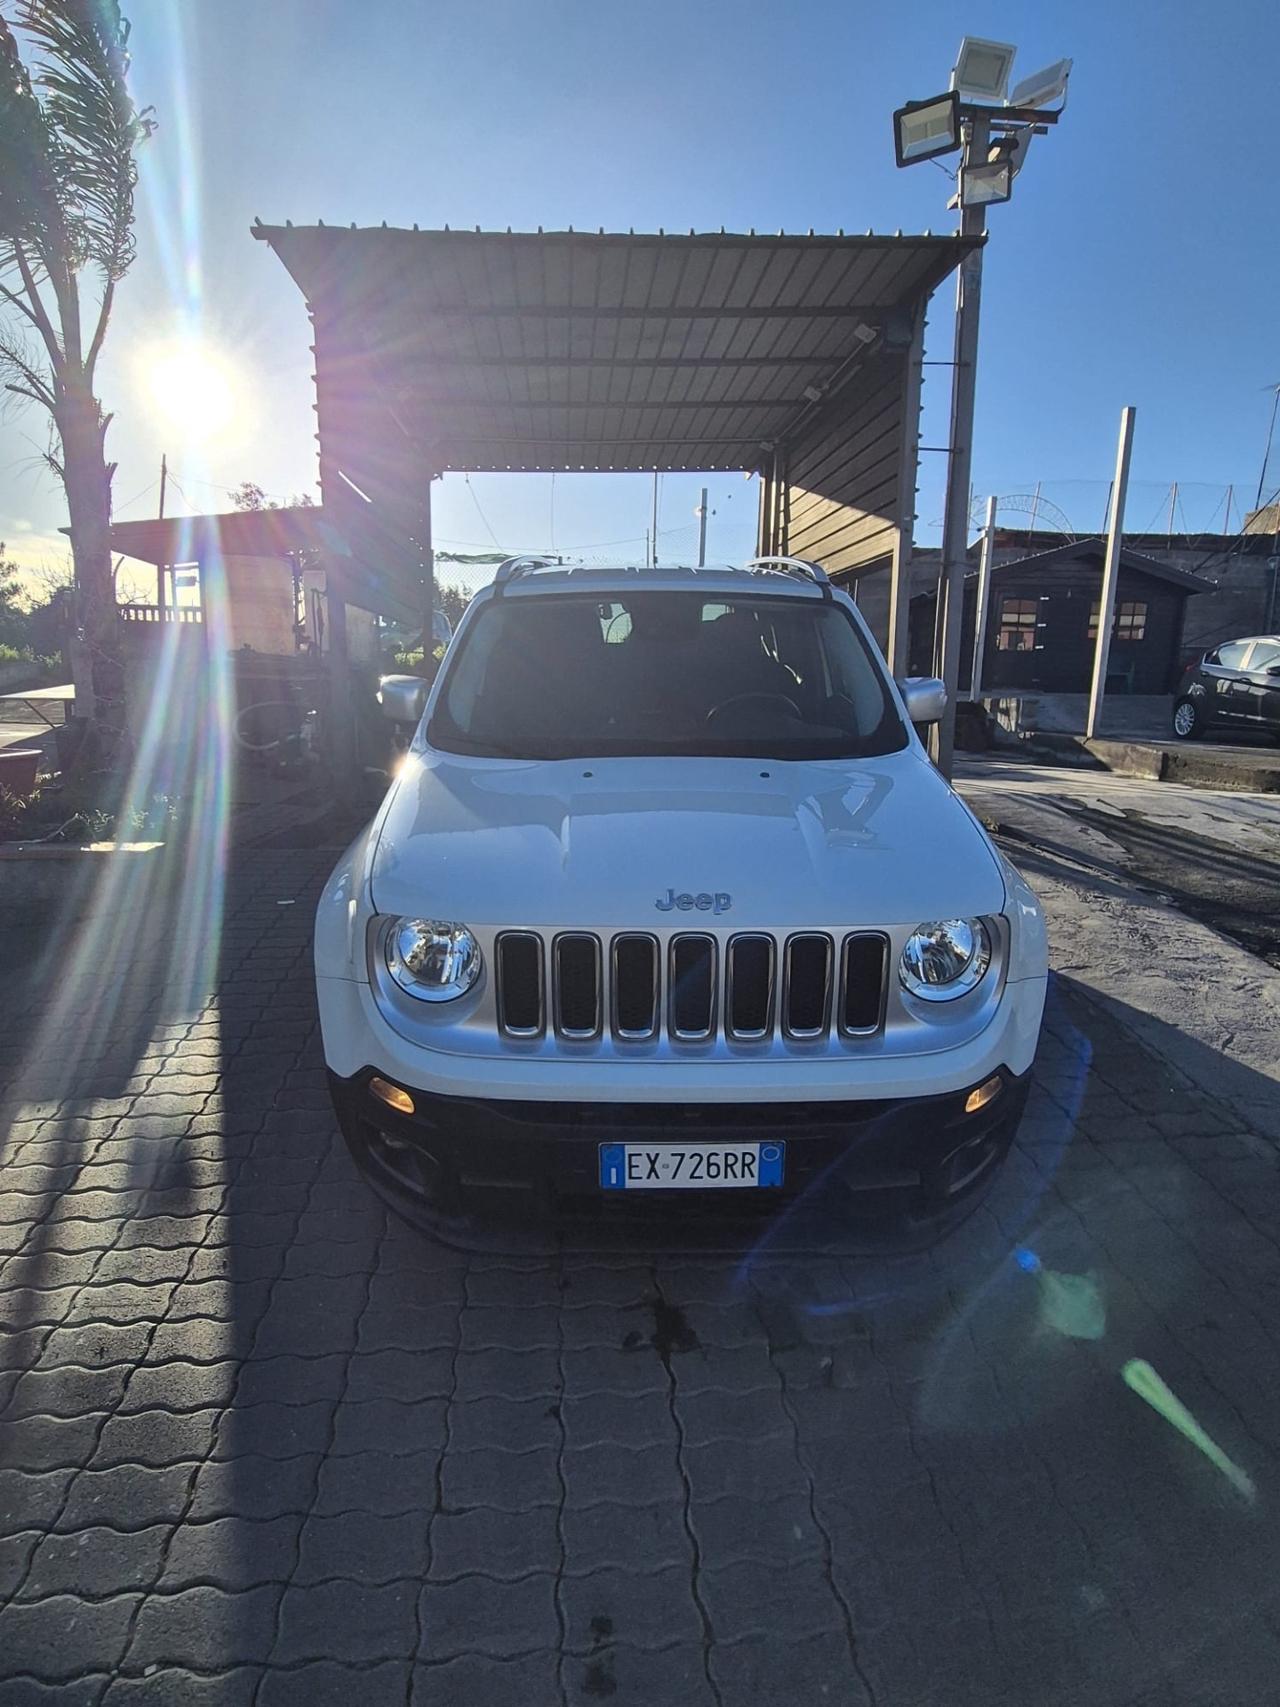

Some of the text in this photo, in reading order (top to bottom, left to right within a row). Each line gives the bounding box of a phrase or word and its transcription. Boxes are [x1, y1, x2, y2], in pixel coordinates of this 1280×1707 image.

[655, 889, 732, 915] Jeep
[611, 1167, 616, 1184] I
[627, 1152, 756, 1180] EX 726RR
